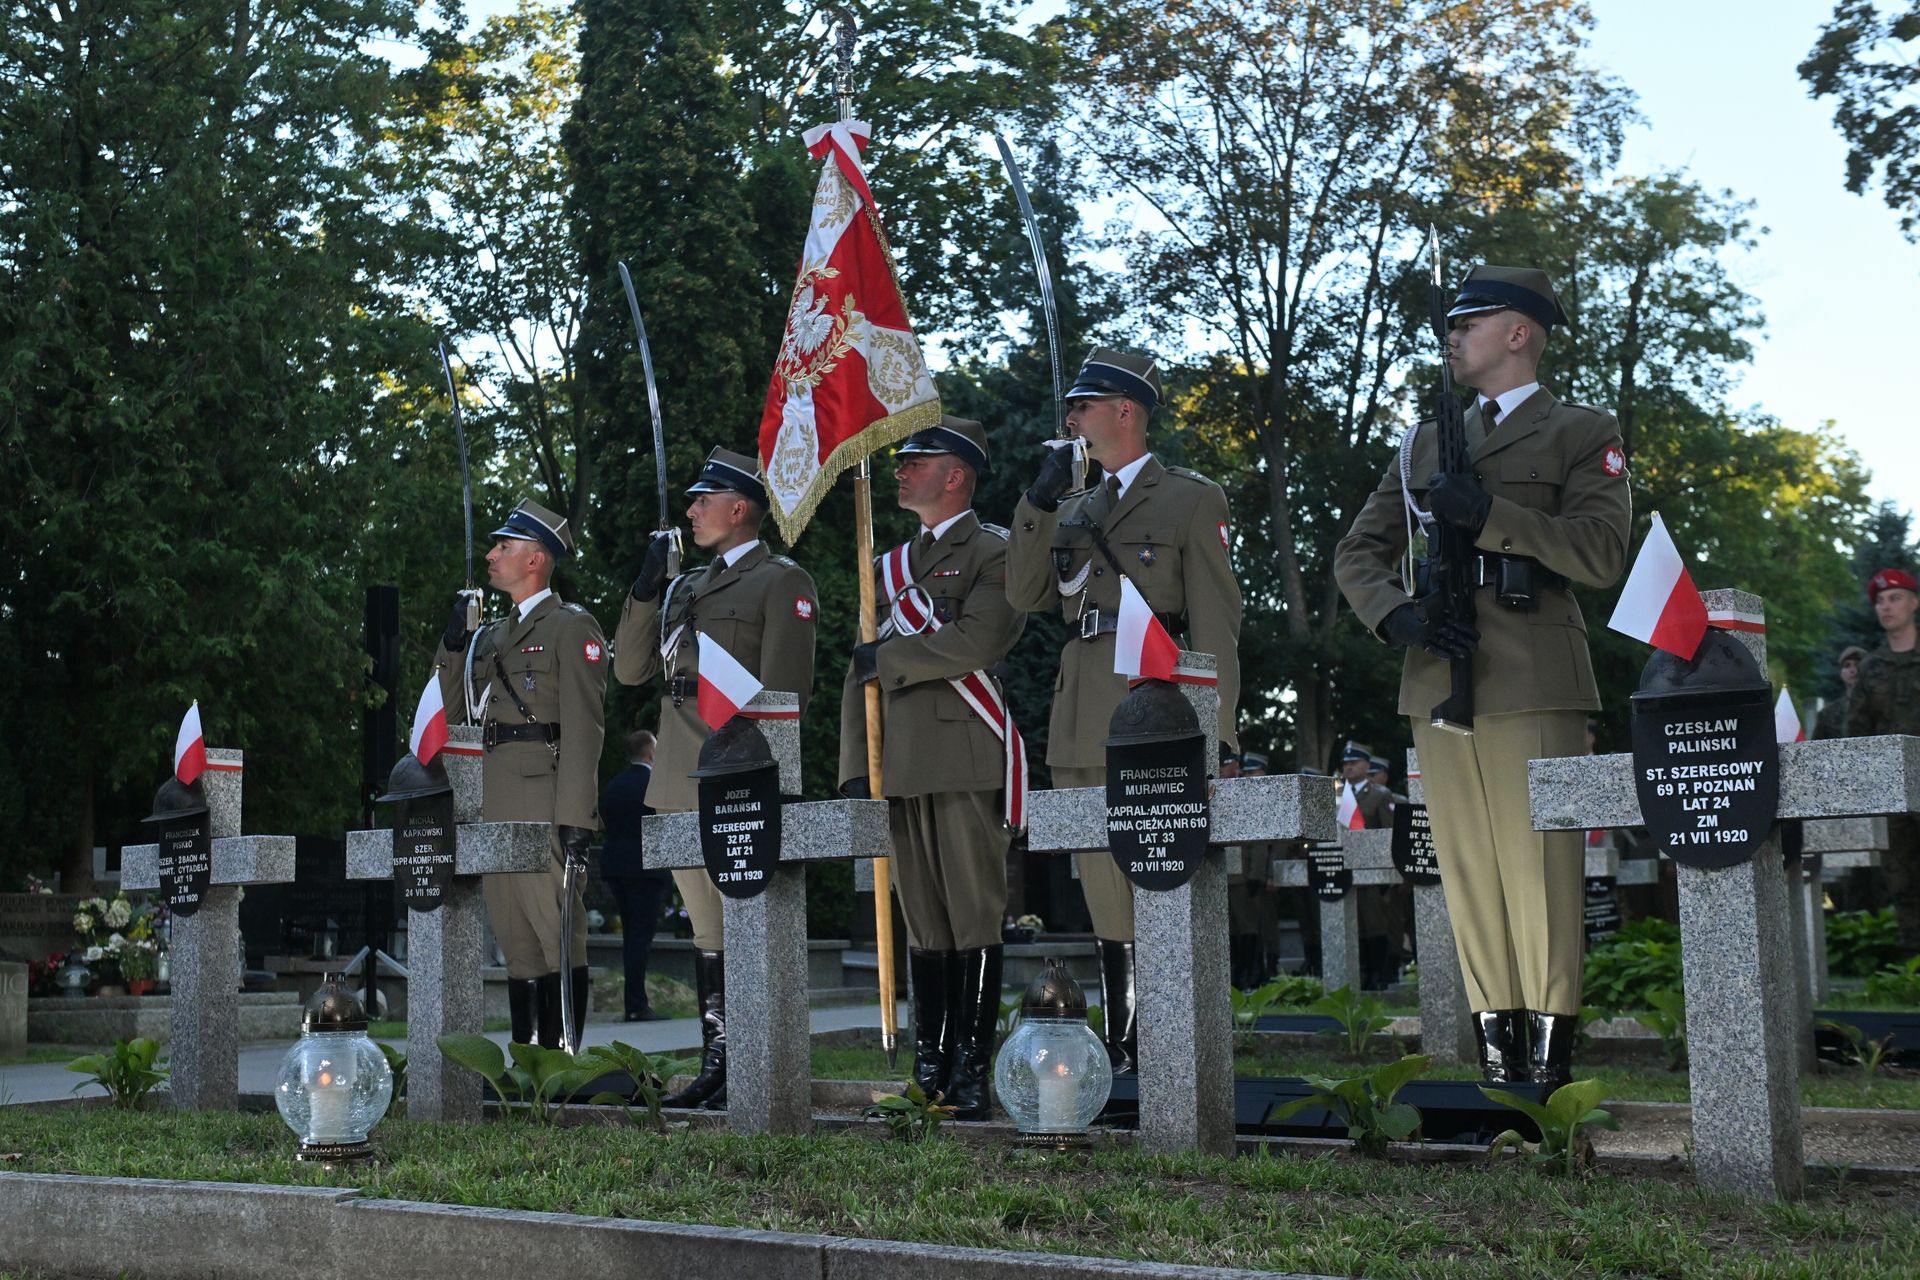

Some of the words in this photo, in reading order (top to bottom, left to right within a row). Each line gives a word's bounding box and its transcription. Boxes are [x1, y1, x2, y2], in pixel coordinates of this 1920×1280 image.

[1664, 718, 1738, 736] CZESŁAW
[1668, 736, 1736, 754] PALIŃSKI
[1120, 766, 1188, 780] FRANCISZEK
[1646, 768, 1667, 781] ST.
[1671, 761, 1764, 779] SZEREGOWY
[1126, 782, 1184, 796] MURAWIEC
[1656, 783, 1674, 796] 69
[1678, 782, 1689, 795] P.
[1694, 776, 1755, 794] POZNAŃ
[715, 801, 760, 814] BARAŃSKI
[1683, 798, 1708, 811] LAT
[1713, 796, 1730, 809] 24
[409, 816, 434, 825] MICHAŁ
[1136, 818, 1174, 832] CIĘŻKA
[1174, 819, 1189, 828] NR
[1190, 818, 1207, 828] 610
[1697, 814, 1718, 828] ZM
[404, 827, 443, 838] KAPKOWSKI
[712, 820, 765, 834] SZEREGOWY
[165, 828, 200, 840] FRANCISZEK
[727, 835, 737, 844] 32
[739, 834, 752, 843] P.P.
[1139, 833, 1158, 844] LAT
[1162, 832, 1175, 843] 33
[1421, 832, 1432, 840] SZ
[1670, 833, 1686, 846] 21
[1690, 832, 1710, 844] VII
[1714, 830, 1748, 843] 1920
[173, 840, 192, 849] PISKŁO
[415, 845, 434, 853] SZER.
[727, 847, 742, 856] LAT
[744, 846, 753, 855] 21
[1411, 848, 1424, 856] LAT
[178, 863, 208, 874] CYTADELA
[412, 866, 423, 875] LAT
[426, 866, 433, 874] 24
[734, 860, 746, 869] ZM
[1131, 862, 1143, 872] 20
[1146, 861, 1158, 872] VII
[1160, 860, 1184, 871] 1920
[718, 873, 728, 882] 23
[730, 872, 741, 881] VII
[744, 870, 763, 880] 1920
[1426, 867, 1441, 875] 1920
[174, 875, 183, 884] LAT
[186, 874, 192, 882] 19
[406, 889, 413, 897] 24
[416, 888, 424, 896] VII
[426, 888, 440, 896] 1920
[171, 896, 176, 904] 21
[186, 894, 198, 902] 1920
